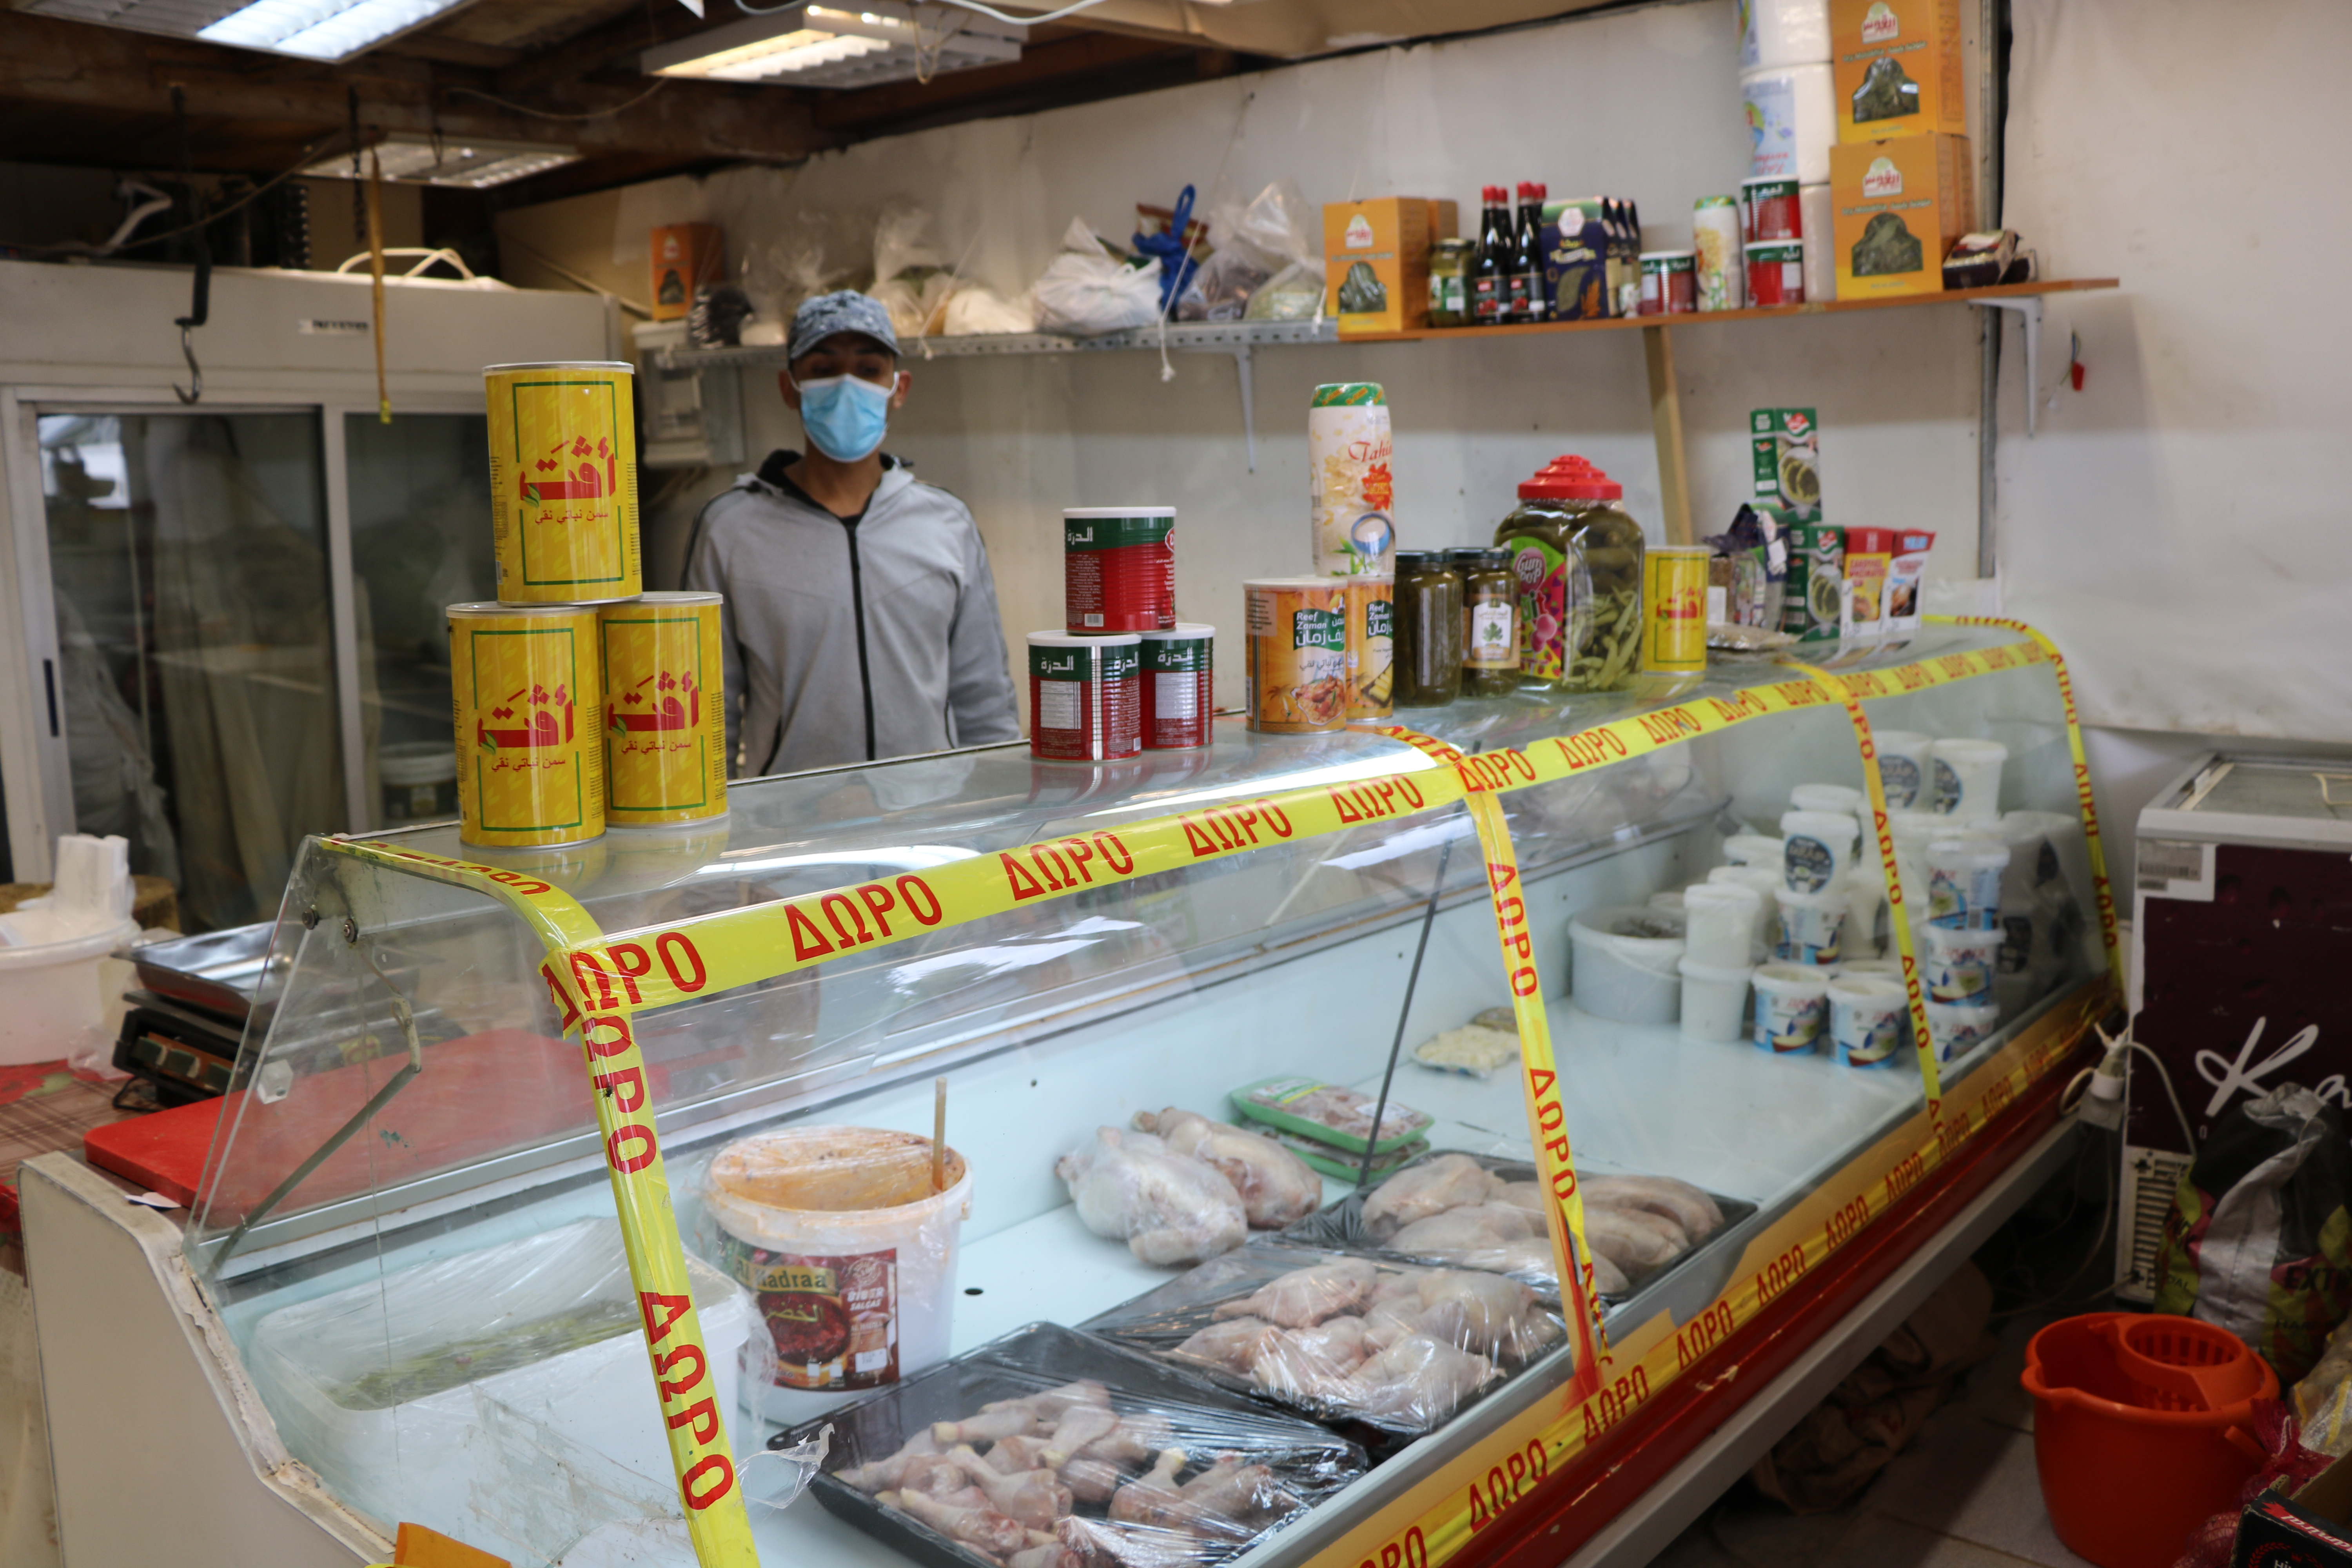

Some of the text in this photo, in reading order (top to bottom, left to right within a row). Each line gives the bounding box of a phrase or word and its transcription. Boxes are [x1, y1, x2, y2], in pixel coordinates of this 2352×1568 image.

[535, 509, 608, 524] سمن نباتي نقي
[1296, 612, 1318, 622] Reef
[1369, 603, 1385, 612] Reef
[1296, 621, 1327, 630] Zaman
[1296, 630, 1326, 646] زمان
[621, 740, 691, 755] سمن نباتي نقي
[1384, 725, 1462, 762] ΔΩΡ
[492, 757, 566, 772] سمن نباتي نقي
[784, 875, 942, 962] ΔΩΡΟ
[999, 831, 1134, 901] ΔΩΡΟ
[1177, 798, 1292, 857] ΔΩΡΟ
[1325, 773, 1424, 824] ΔΩΡΟ
[1454, 749, 1536, 793] ΔΩΡΟ
[1555, 728, 1627, 770] ΔΩΡΟ
[1638, 707, 1702, 745] ΔΩΡΟ
[1775, 679, 1830, 706] ΔΩΡΟ
[1873, 810, 1902, 904] ΔΩΡΟ
[1902, 955, 1930, 1049] ΔΩΡΟ
[1487, 862, 1576, 1201] ΔΩΡΟ ΔΩΡΟ
[583, 1015, 734, 1510] ΩΡΟ ΔΩΡΟ
[1469, 1438, 1548, 1534] ΔΩΡΟ
[1583, 1365, 1649, 1446] ΔΩΡΟ
[1676, 1299, 1734, 1371] ΔΩΡΟ
[1756, 1244, 1806, 1306] ΔΩΡΟ
[1825, 1195, 1869, 1251] ΔΩΡΟ
[1884, 1152, 1923, 1203] ΔΩΡΟ
[2280, 1514, 2352, 1553] dmiral
